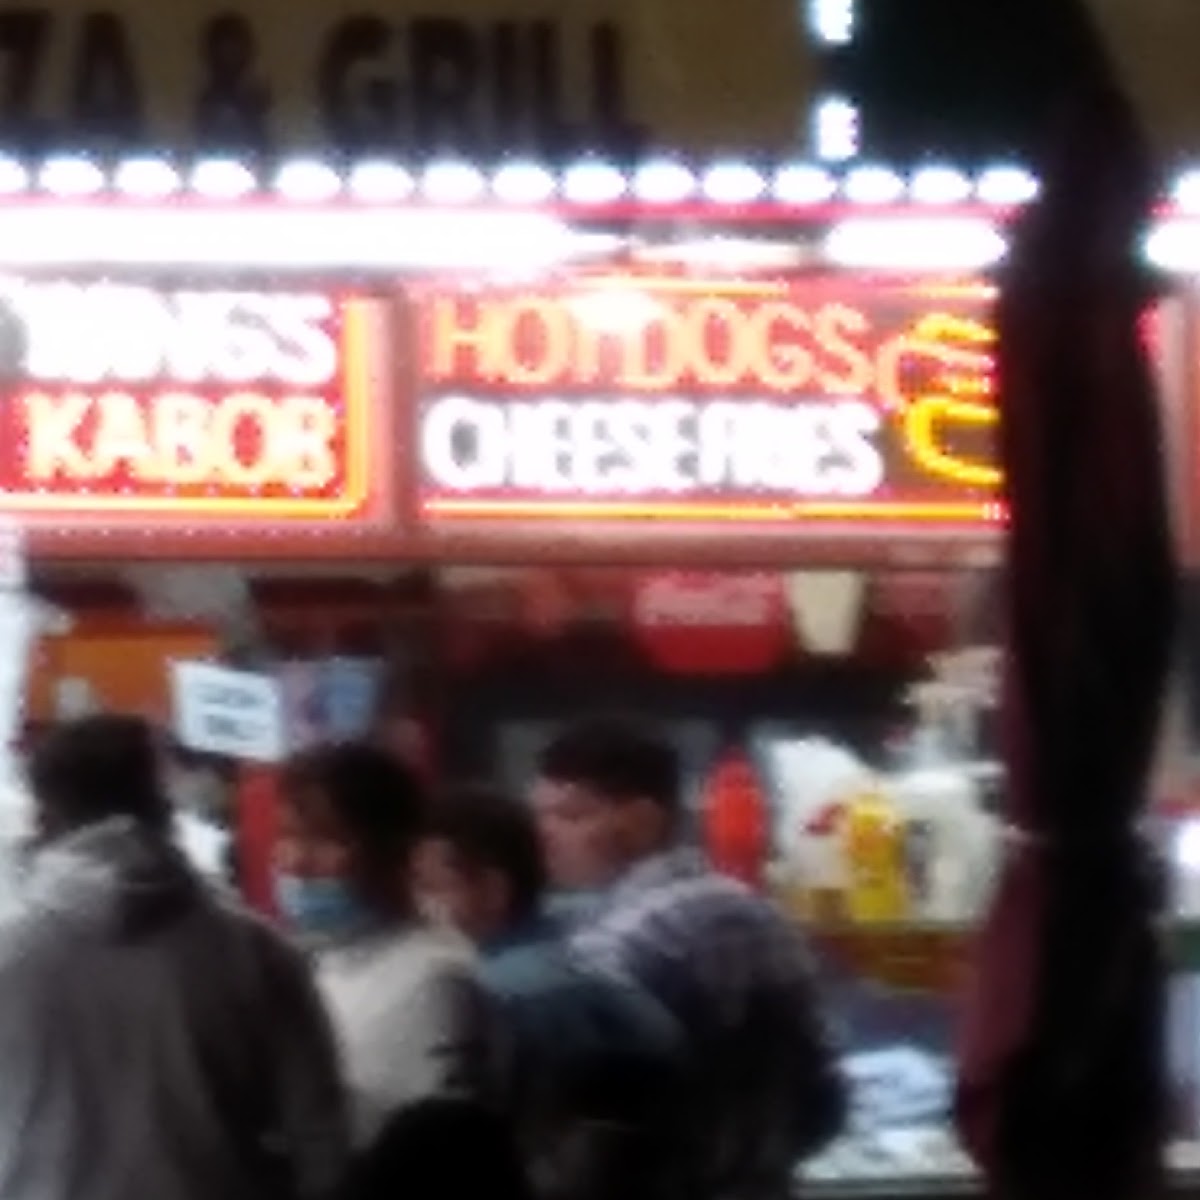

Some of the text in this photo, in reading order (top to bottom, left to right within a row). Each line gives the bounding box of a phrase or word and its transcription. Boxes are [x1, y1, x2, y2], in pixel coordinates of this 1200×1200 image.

[194, 9, 272, 154] &
[317, 11, 650, 162] GRILL
[27, 391, 337, 488] KABOB
